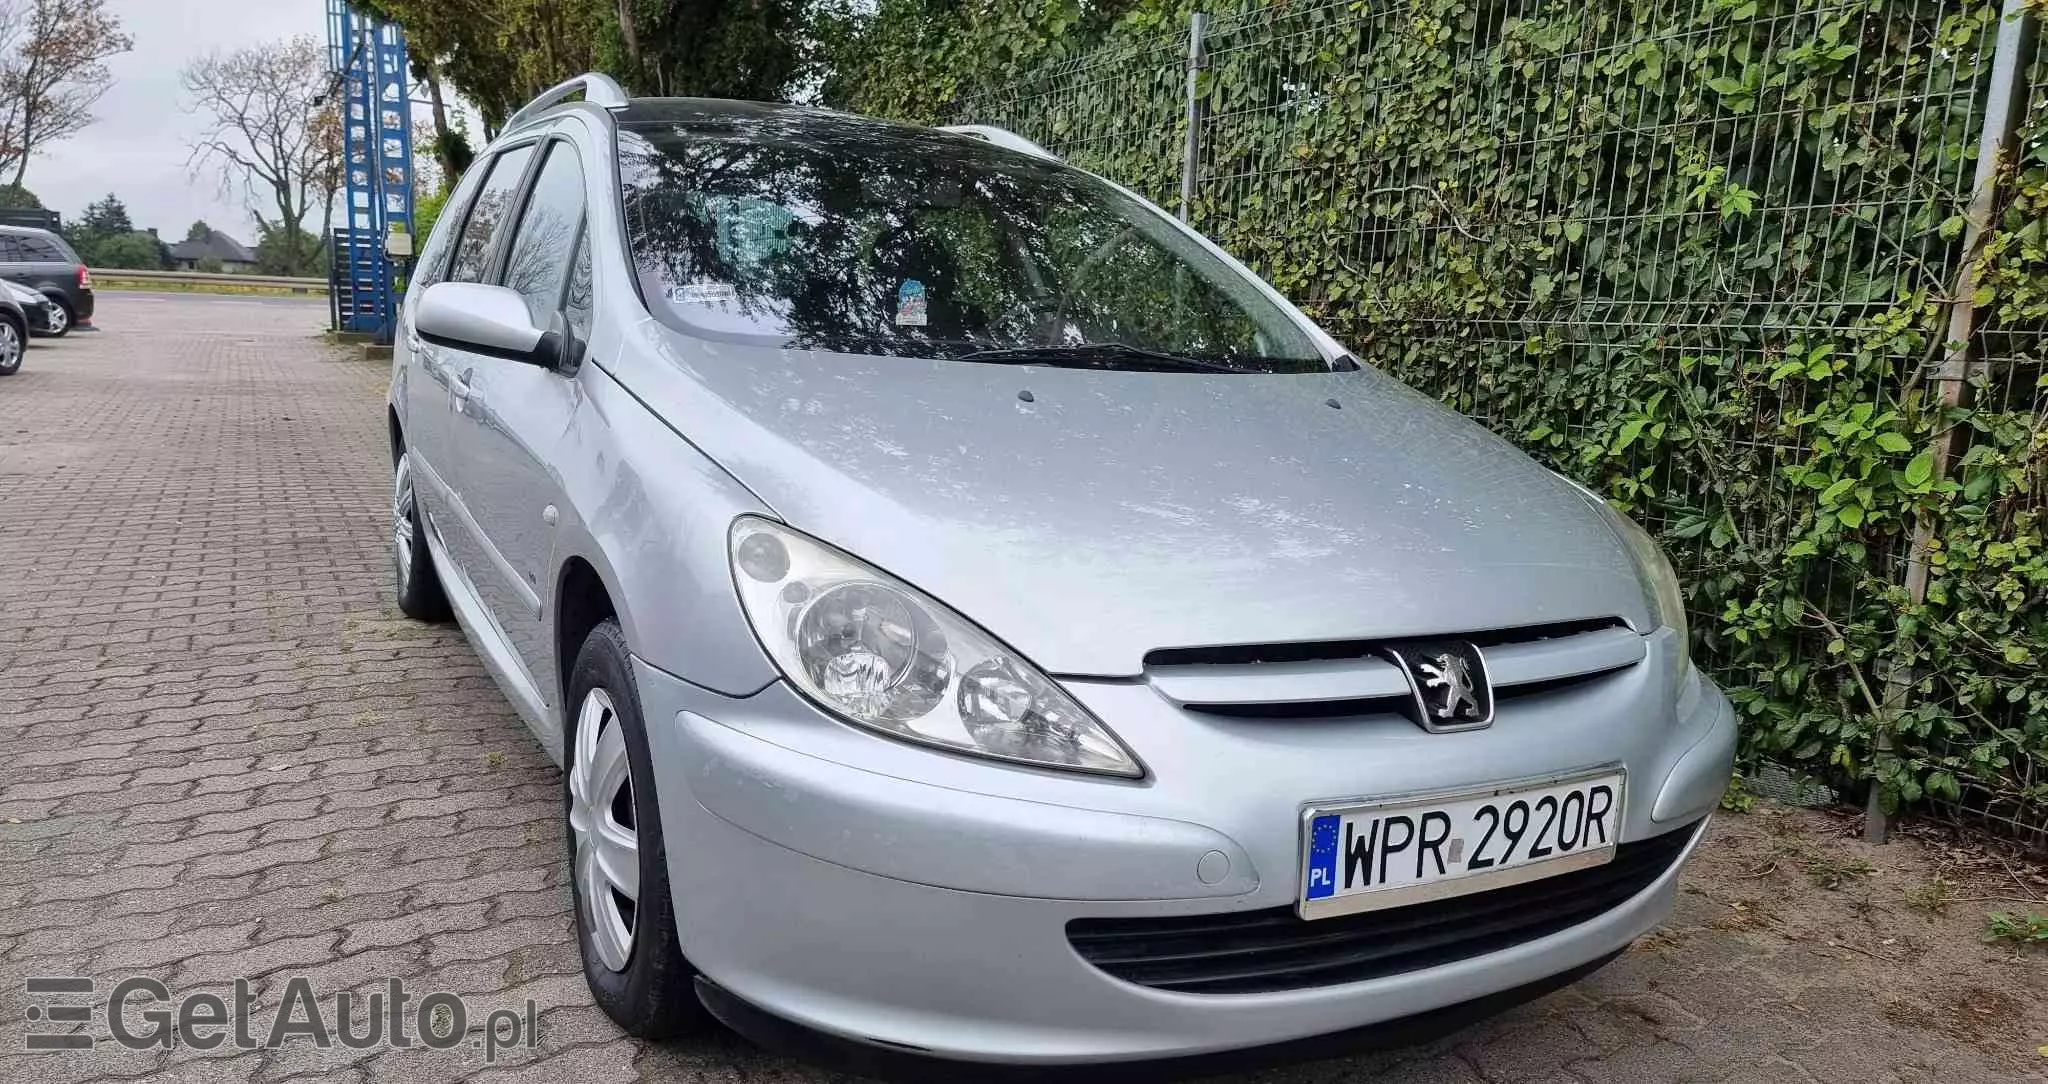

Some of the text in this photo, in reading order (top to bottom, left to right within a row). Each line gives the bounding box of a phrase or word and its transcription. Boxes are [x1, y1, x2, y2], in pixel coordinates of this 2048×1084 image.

[1344, 785, 1613, 889] WPR 2920R
[1311, 868, 1331, 888] PL
